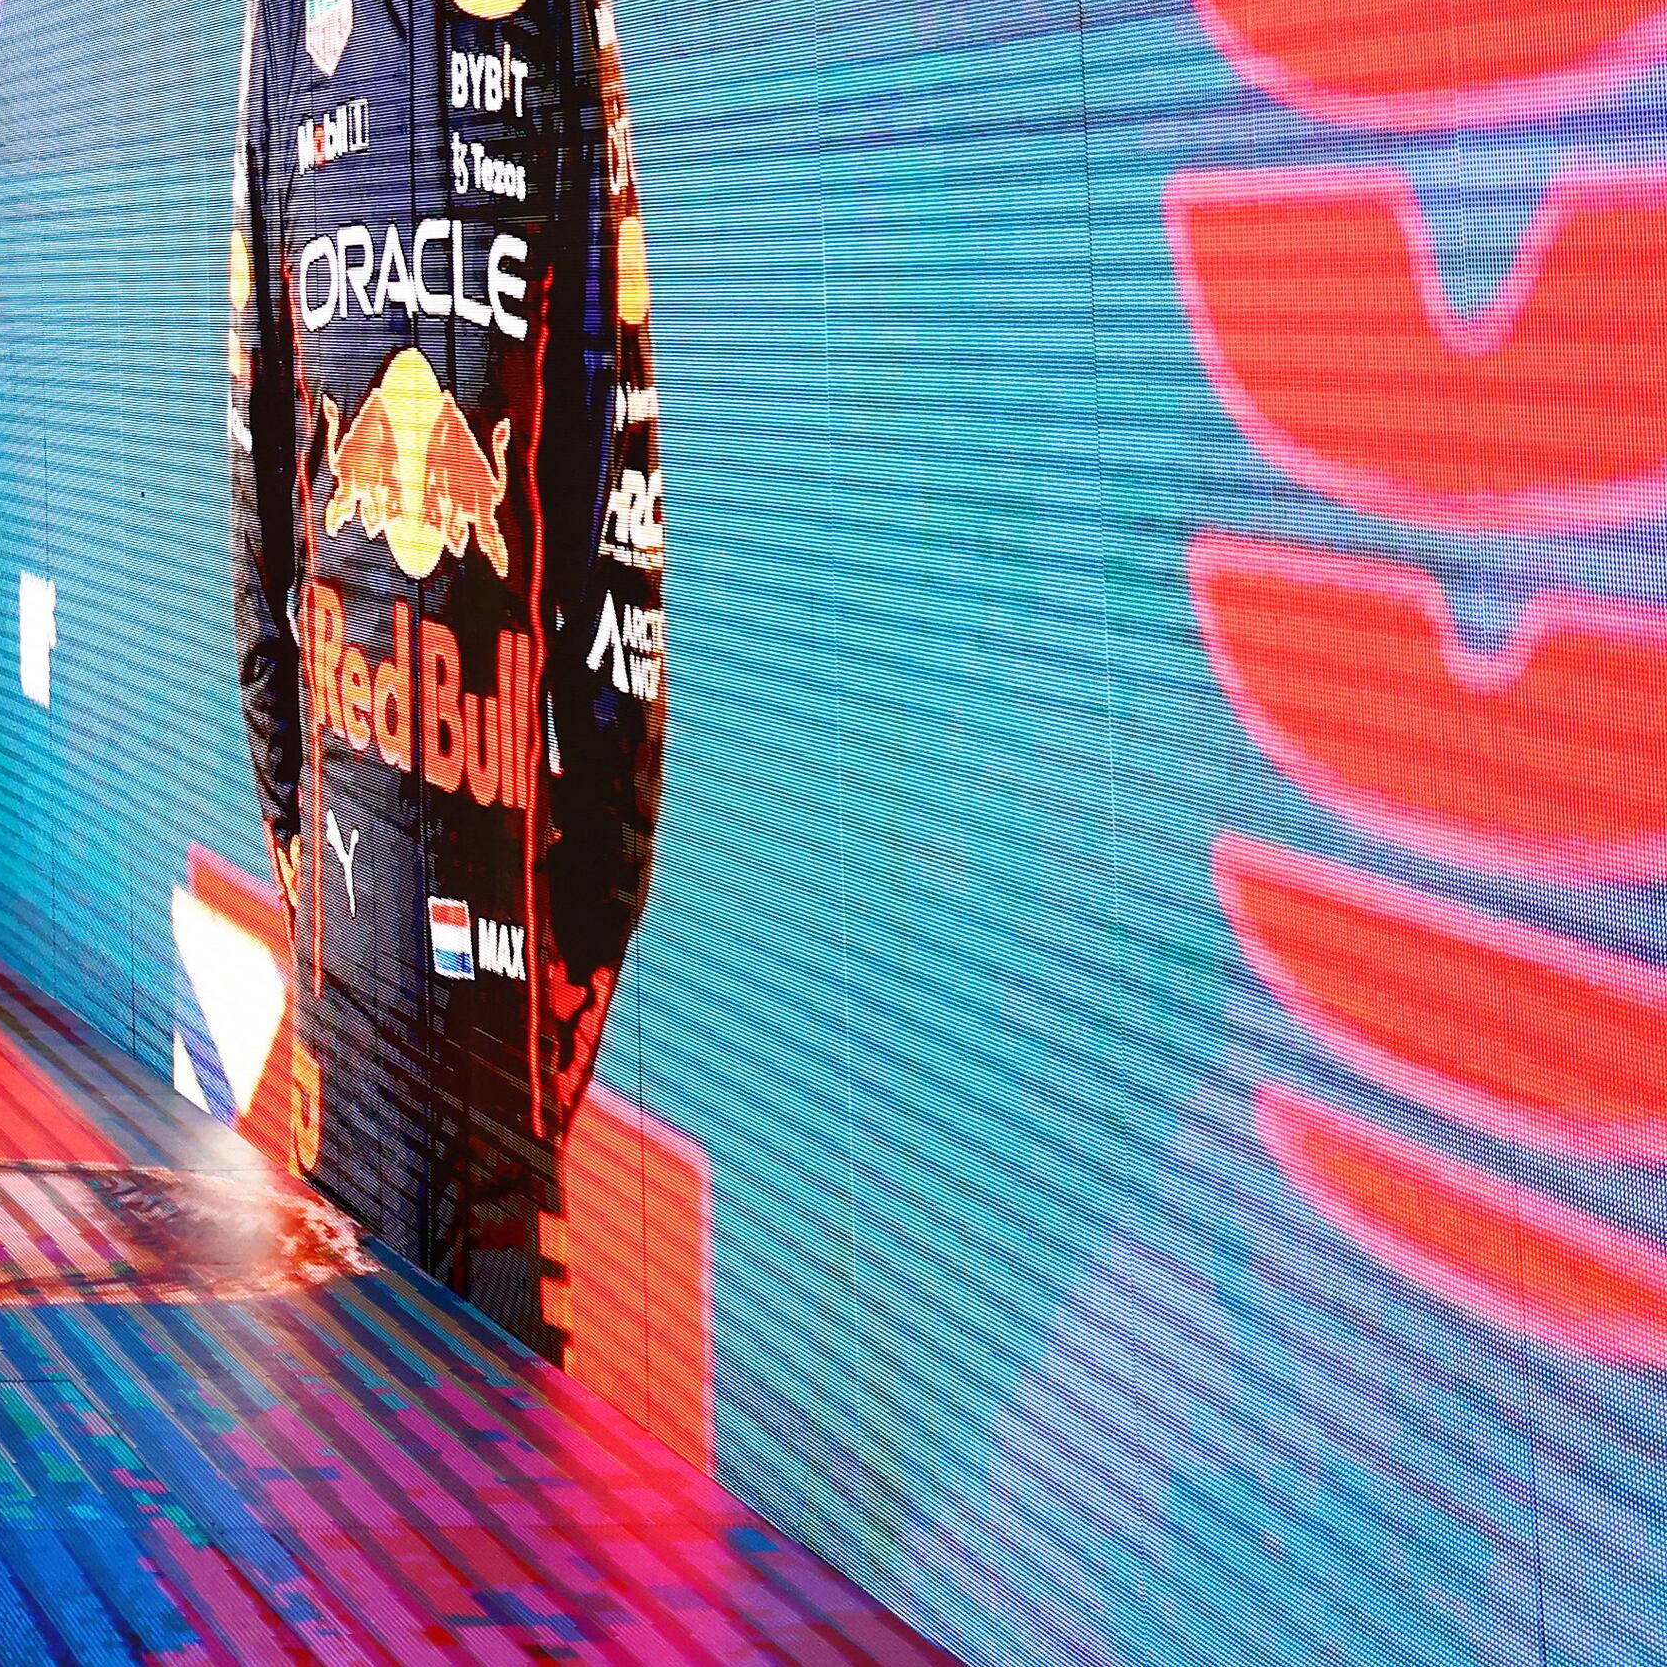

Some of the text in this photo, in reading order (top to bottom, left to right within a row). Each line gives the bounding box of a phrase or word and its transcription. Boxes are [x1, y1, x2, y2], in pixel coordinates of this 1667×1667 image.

[451, 41, 529, 118] BYBIT
[470, 142, 527, 201] Tezos
[299, 219, 529, 341] ORACLE
[306, 580, 531, 810] Red Bull
[477, 917, 527, 981] MAX
